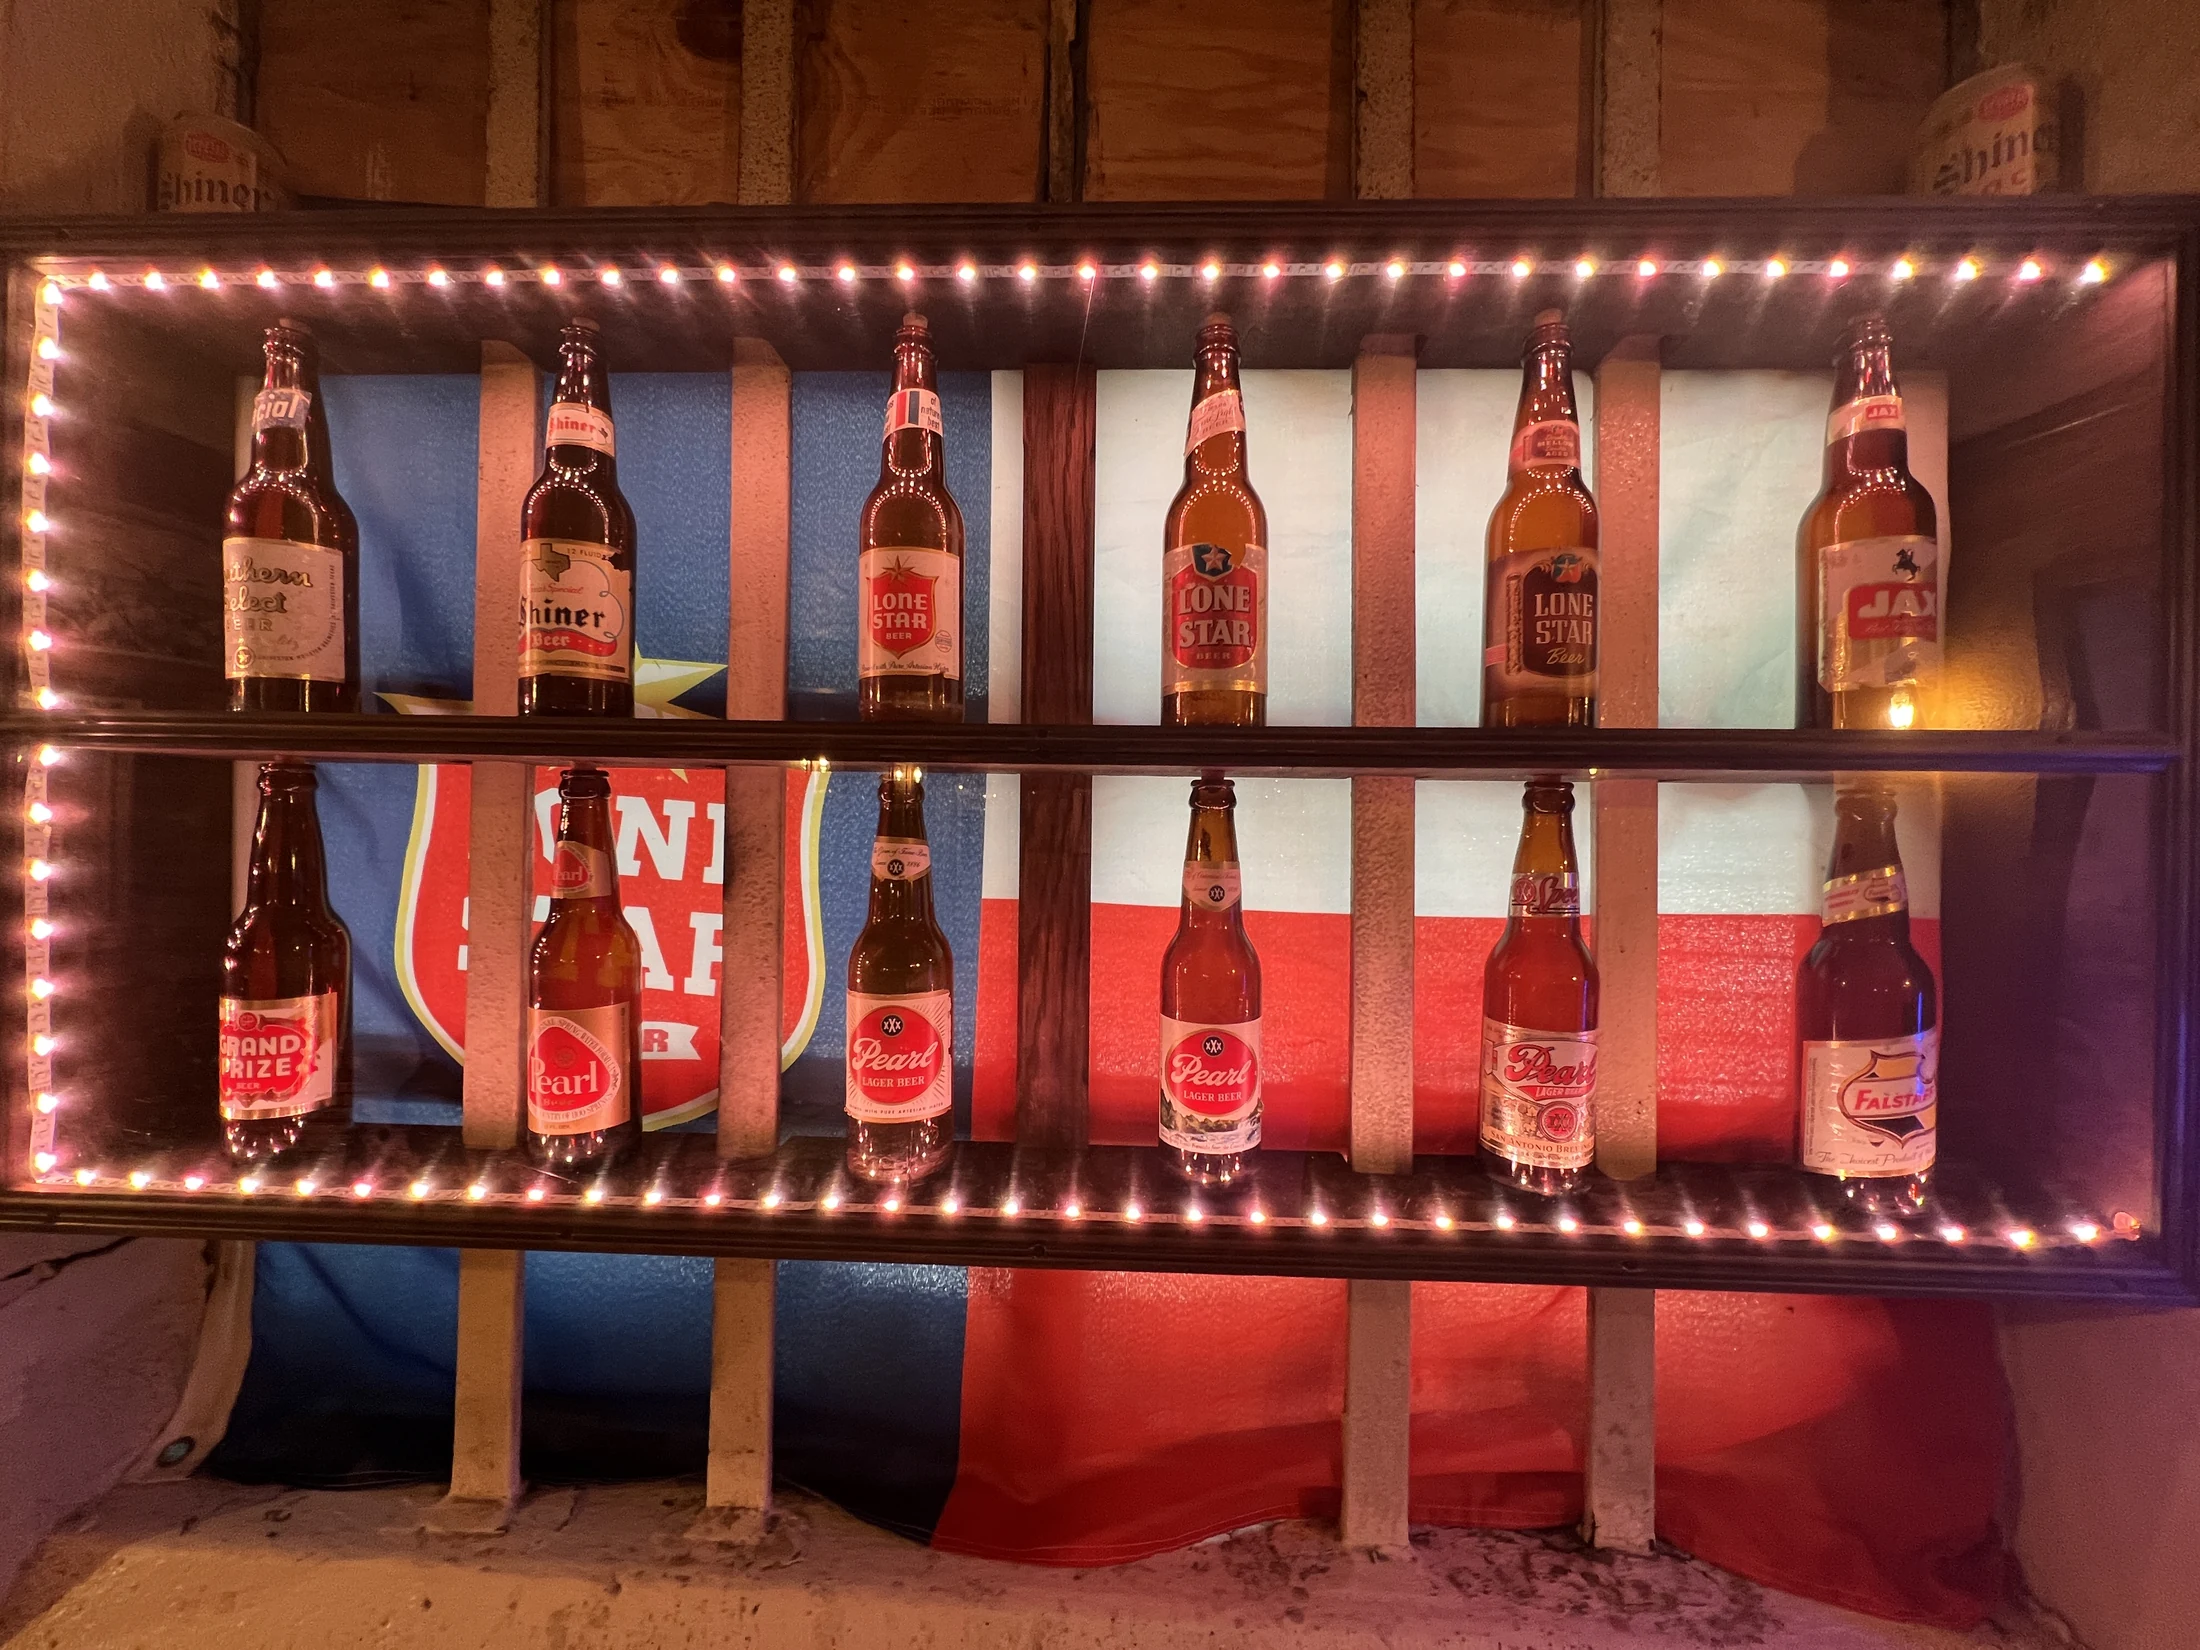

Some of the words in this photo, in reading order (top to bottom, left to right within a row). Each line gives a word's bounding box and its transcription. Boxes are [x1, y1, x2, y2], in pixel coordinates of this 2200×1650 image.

[1868, 406, 1897, 418] JAX
[549, 416, 596, 437] Shiner
[873, 592, 928, 611] LONE
[1179, 584, 1250, 615] LONE
[1534, 592, 1594, 618] LONE
[519, 596, 606, 628] Shiner
[873, 612, 928, 630] STAR
[531, 632, 570, 647] Beer
[886, 632, 912, 640] BEER
[1179, 619, 1250, 647] STAR
[1535, 620, 1593, 645] STAR
[1196, 652, 1232, 660] BEER
[1546, 647, 1586, 665] Beer
[220, 1034, 301, 1057] GRAND
[852, 1037, 939, 1071] Pearl
[221, 1057, 292, 1079] PRIZE
[1170, 1053, 1252, 1087] Pearl
[1504, 1043, 1597, 1085] Pearl
[530, 1056, 598, 1096] Pearl
[862, 1077, 894, 1088] LAGER
[897, 1075, 925, 1087] BEER
[1183, 1090, 1215, 1102] LAGER
[1218, 1091, 1243, 1102] BEER
[1535, 1086, 1564, 1098] LAGER
[1491, 1131, 1506, 1142] SAN
[1510, 1138, 1553, 1153] ANTONIO
